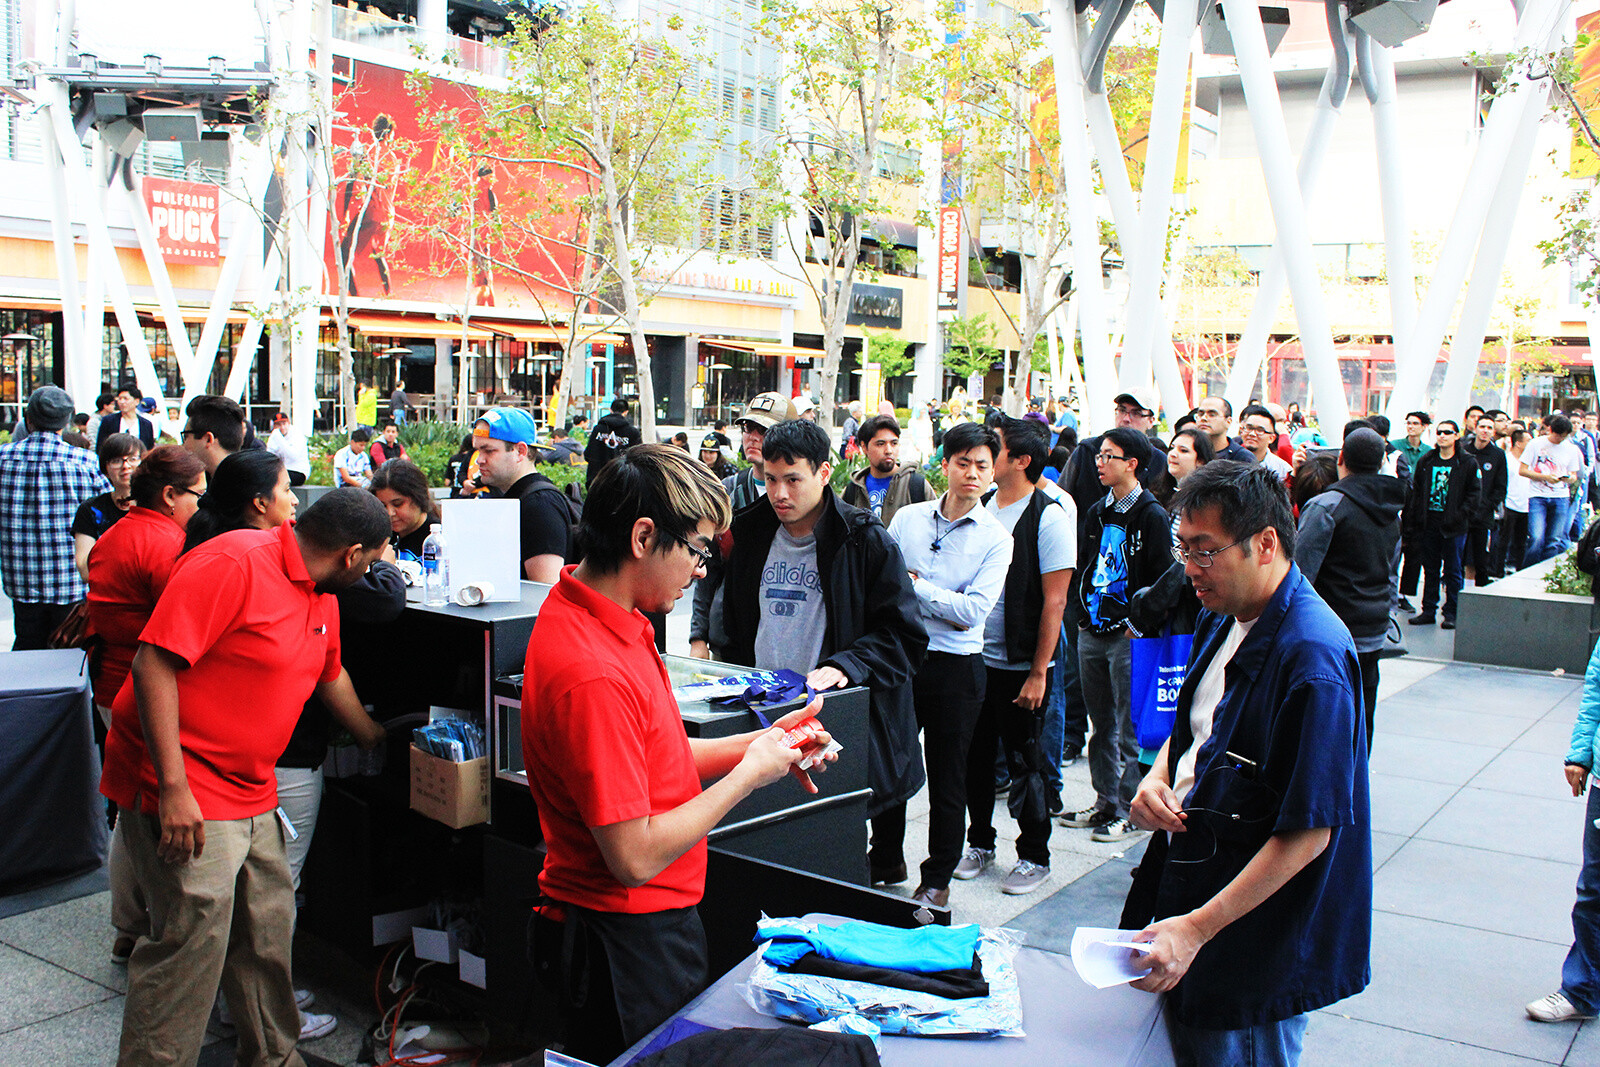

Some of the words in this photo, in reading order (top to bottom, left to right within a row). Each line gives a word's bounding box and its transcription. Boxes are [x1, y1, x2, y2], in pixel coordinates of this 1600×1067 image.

[152, 190, 215, 210] WOLFGANG
[152, 206, 217, 245] PUCK
[942, 211, 958, 253] CONGA
[183, 249, 216, 259] GRILL
[941, 255, 957, 292] ROOM
[760, 562, 824, 594] dida
